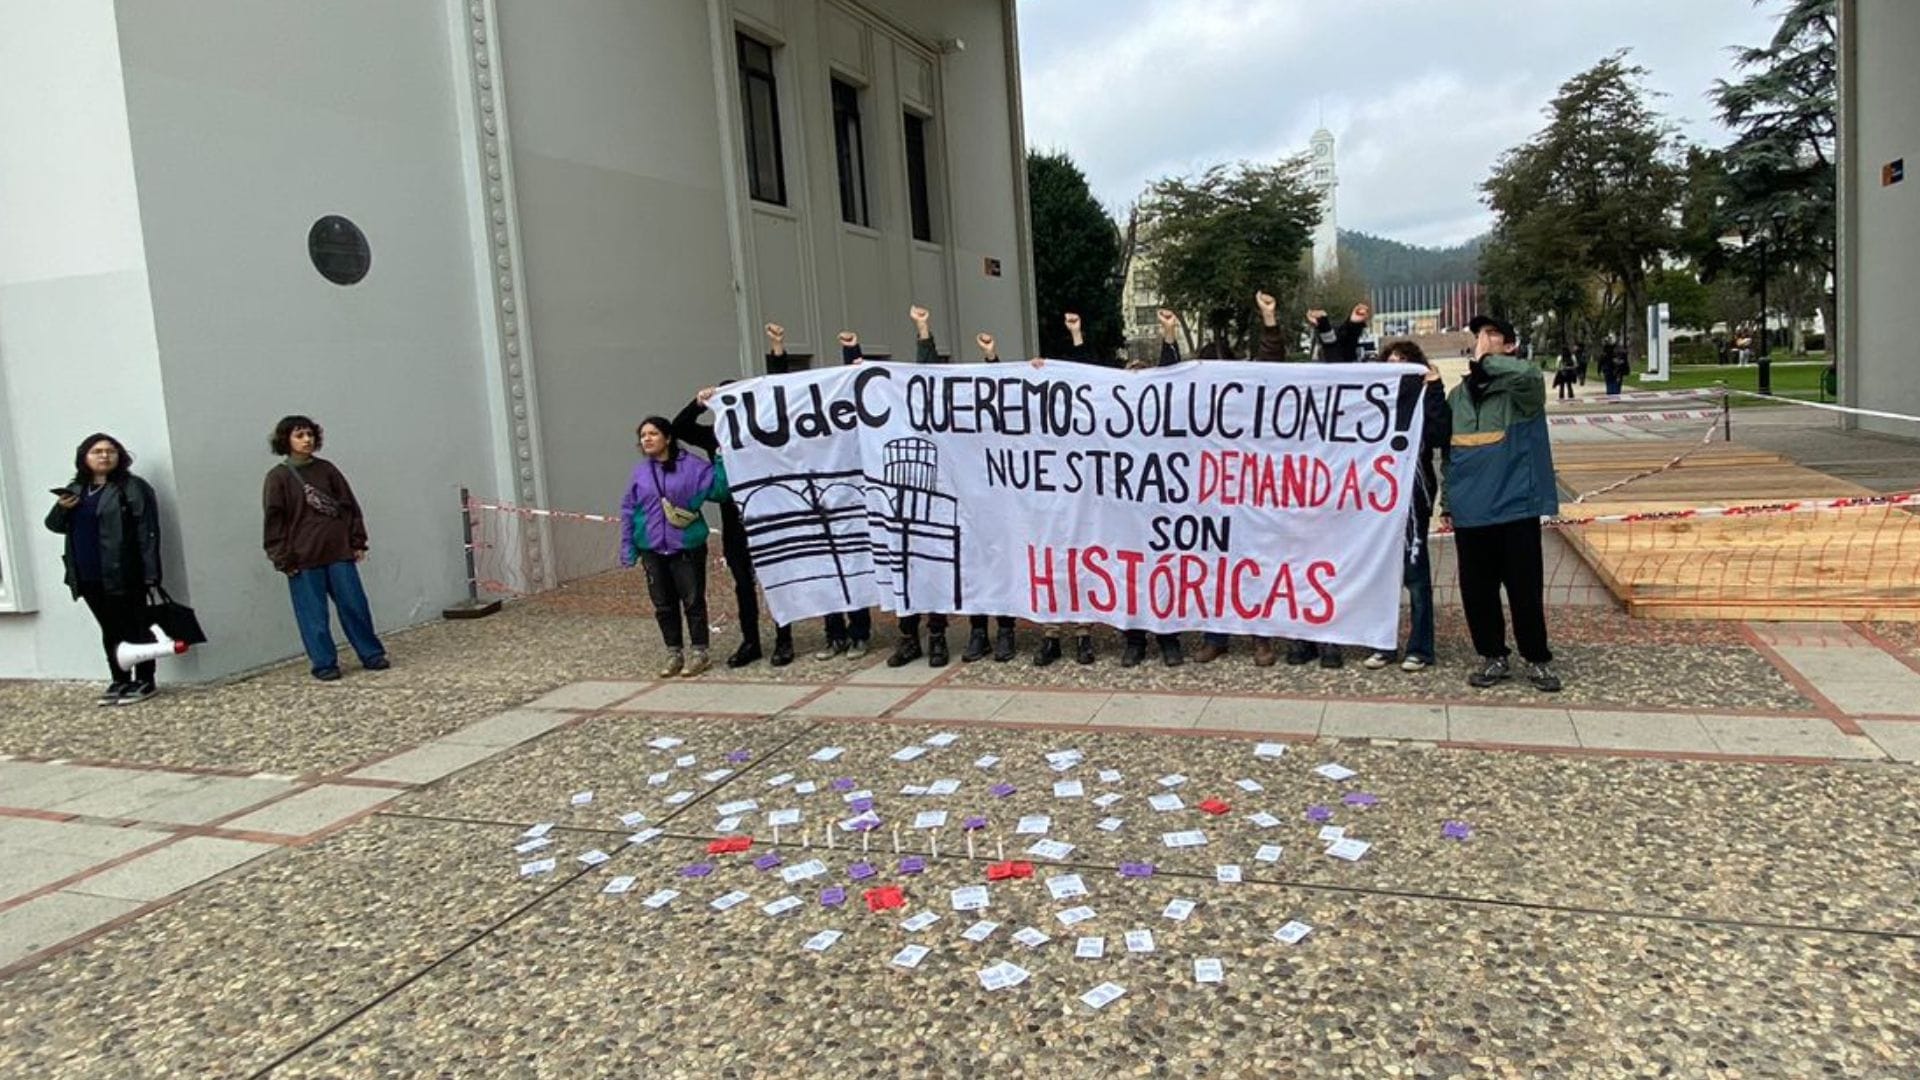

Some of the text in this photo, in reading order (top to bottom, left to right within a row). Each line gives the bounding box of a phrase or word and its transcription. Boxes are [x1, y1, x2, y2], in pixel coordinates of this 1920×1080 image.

[906, 374, 1096, 438] QUEREMOS
[1105, 373, 1427, 452] SOLUCIONES!
[985, 448, 1399, 513] NUESTRAS DEMANDAS
[1149, 514, 1231, 552] SON
[1027, 544, 1337, 625] HISTÓRICAS
